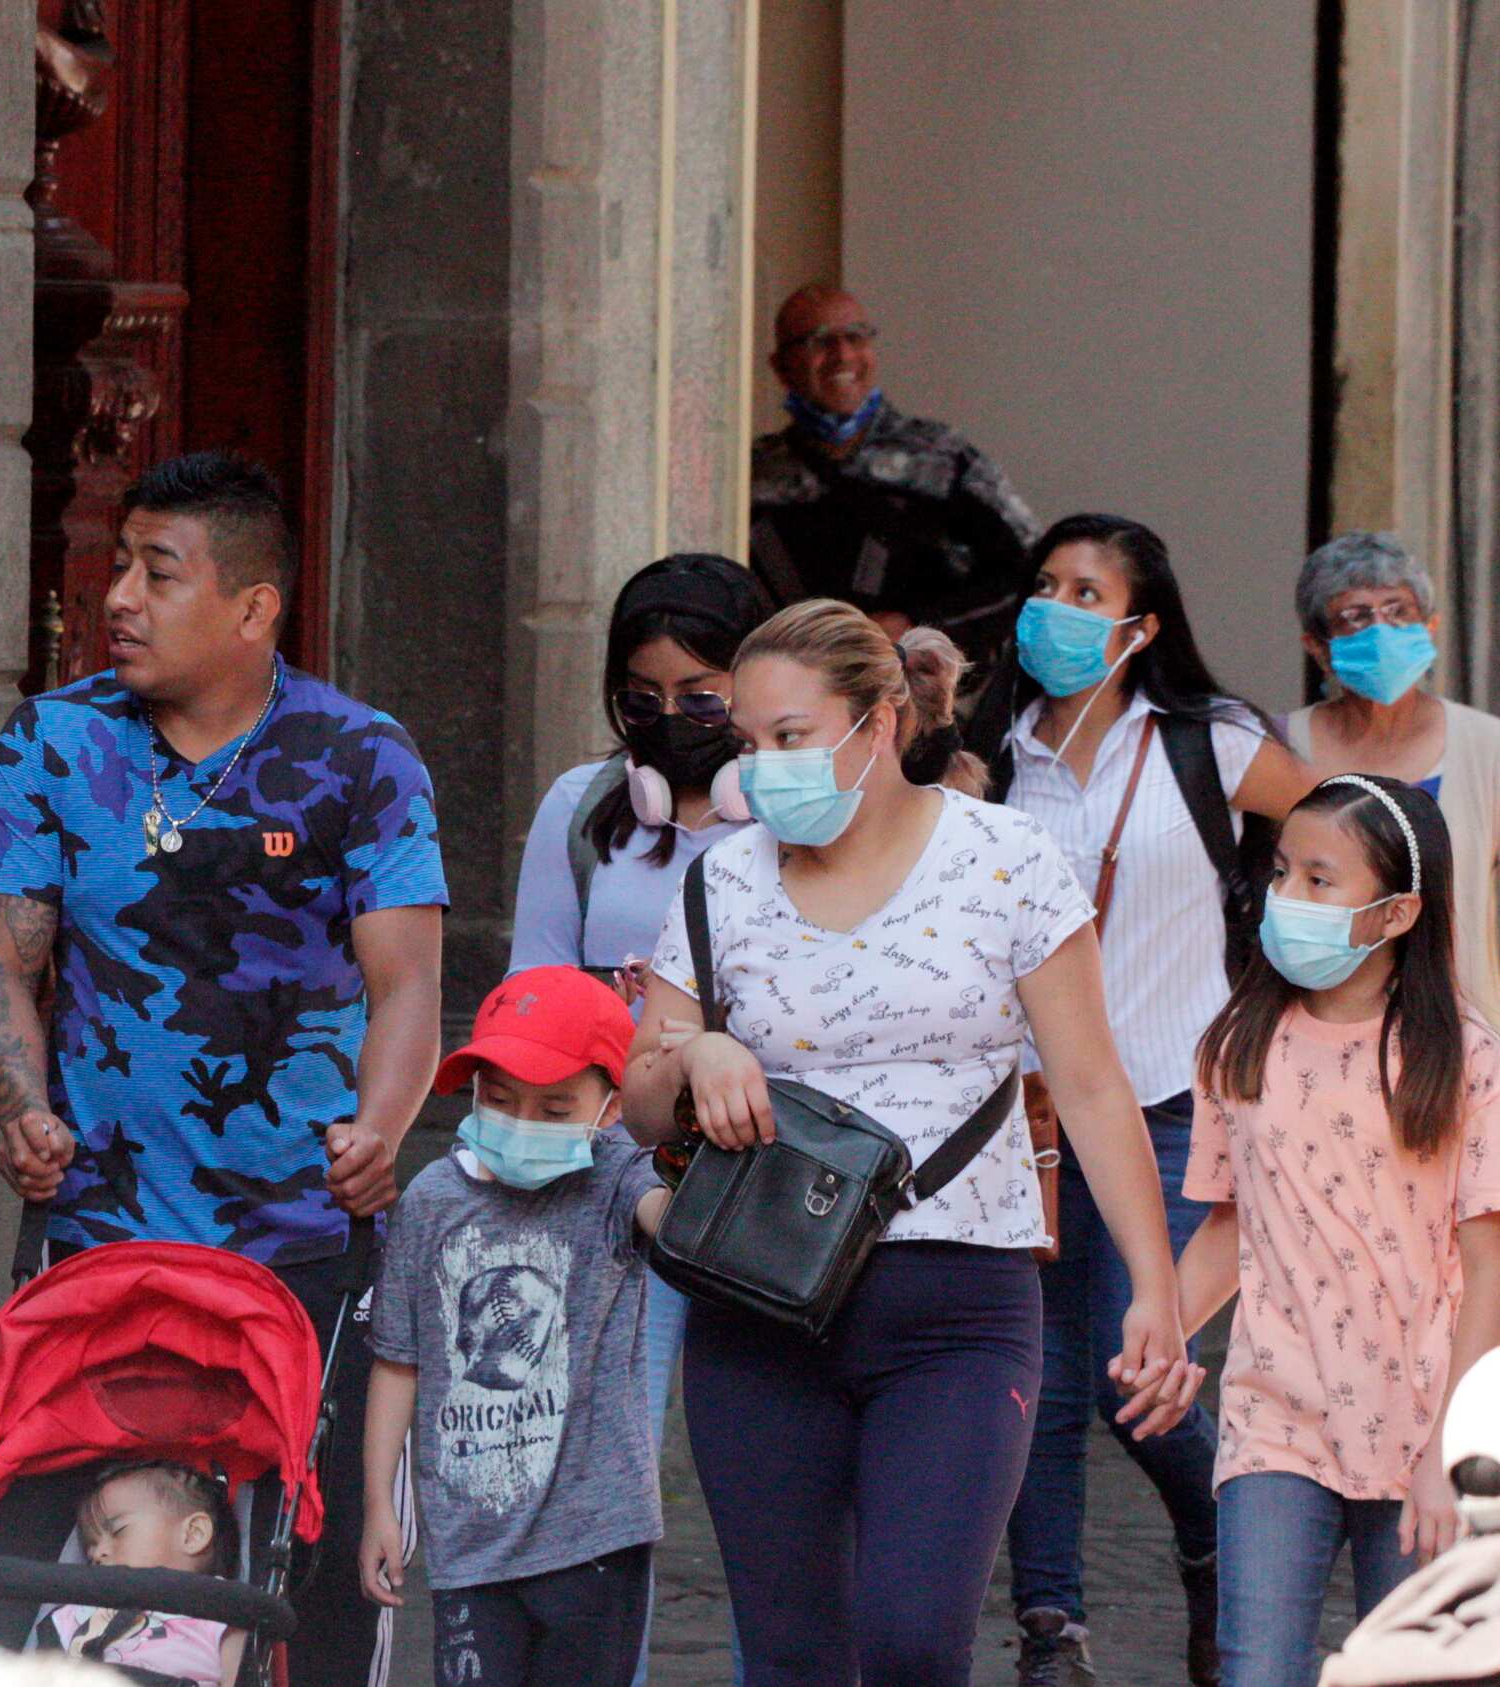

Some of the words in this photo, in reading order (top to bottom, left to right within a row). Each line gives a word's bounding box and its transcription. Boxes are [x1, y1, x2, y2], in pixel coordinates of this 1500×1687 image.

[881, 942, 915, 969] Lazy
[917, 958, 952, 981] days
[820, 1005, 852, 1030] Lazy
[851, 984, 879, 1006] days
